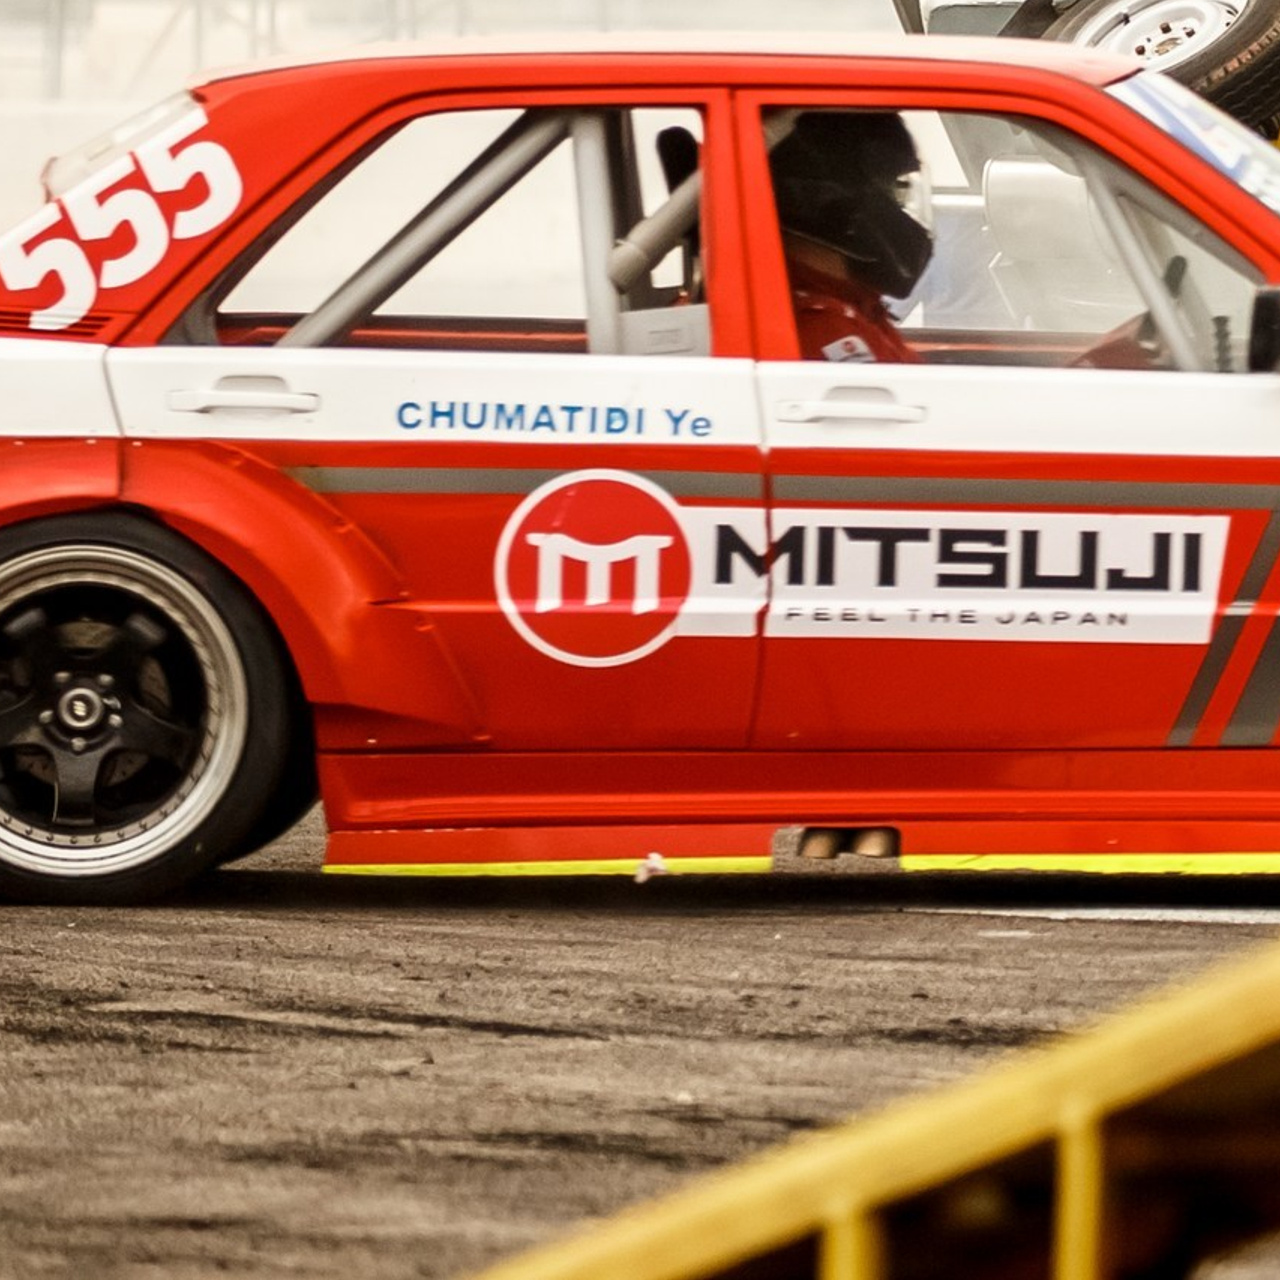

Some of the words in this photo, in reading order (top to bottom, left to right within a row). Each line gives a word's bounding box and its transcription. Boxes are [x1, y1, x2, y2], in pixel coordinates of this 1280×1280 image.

[0, 106, 243, 331] 555
[396, 401, 645, 435] CHUMATIDI
[664, 408, 713, 437] Ye
[713, 524, 1204, 593] MITSUJI
[785, 607, 887, 623] FEEL
[906, 608, 978, 624] THE
[995, 610, 1129, 626] JAPAN
